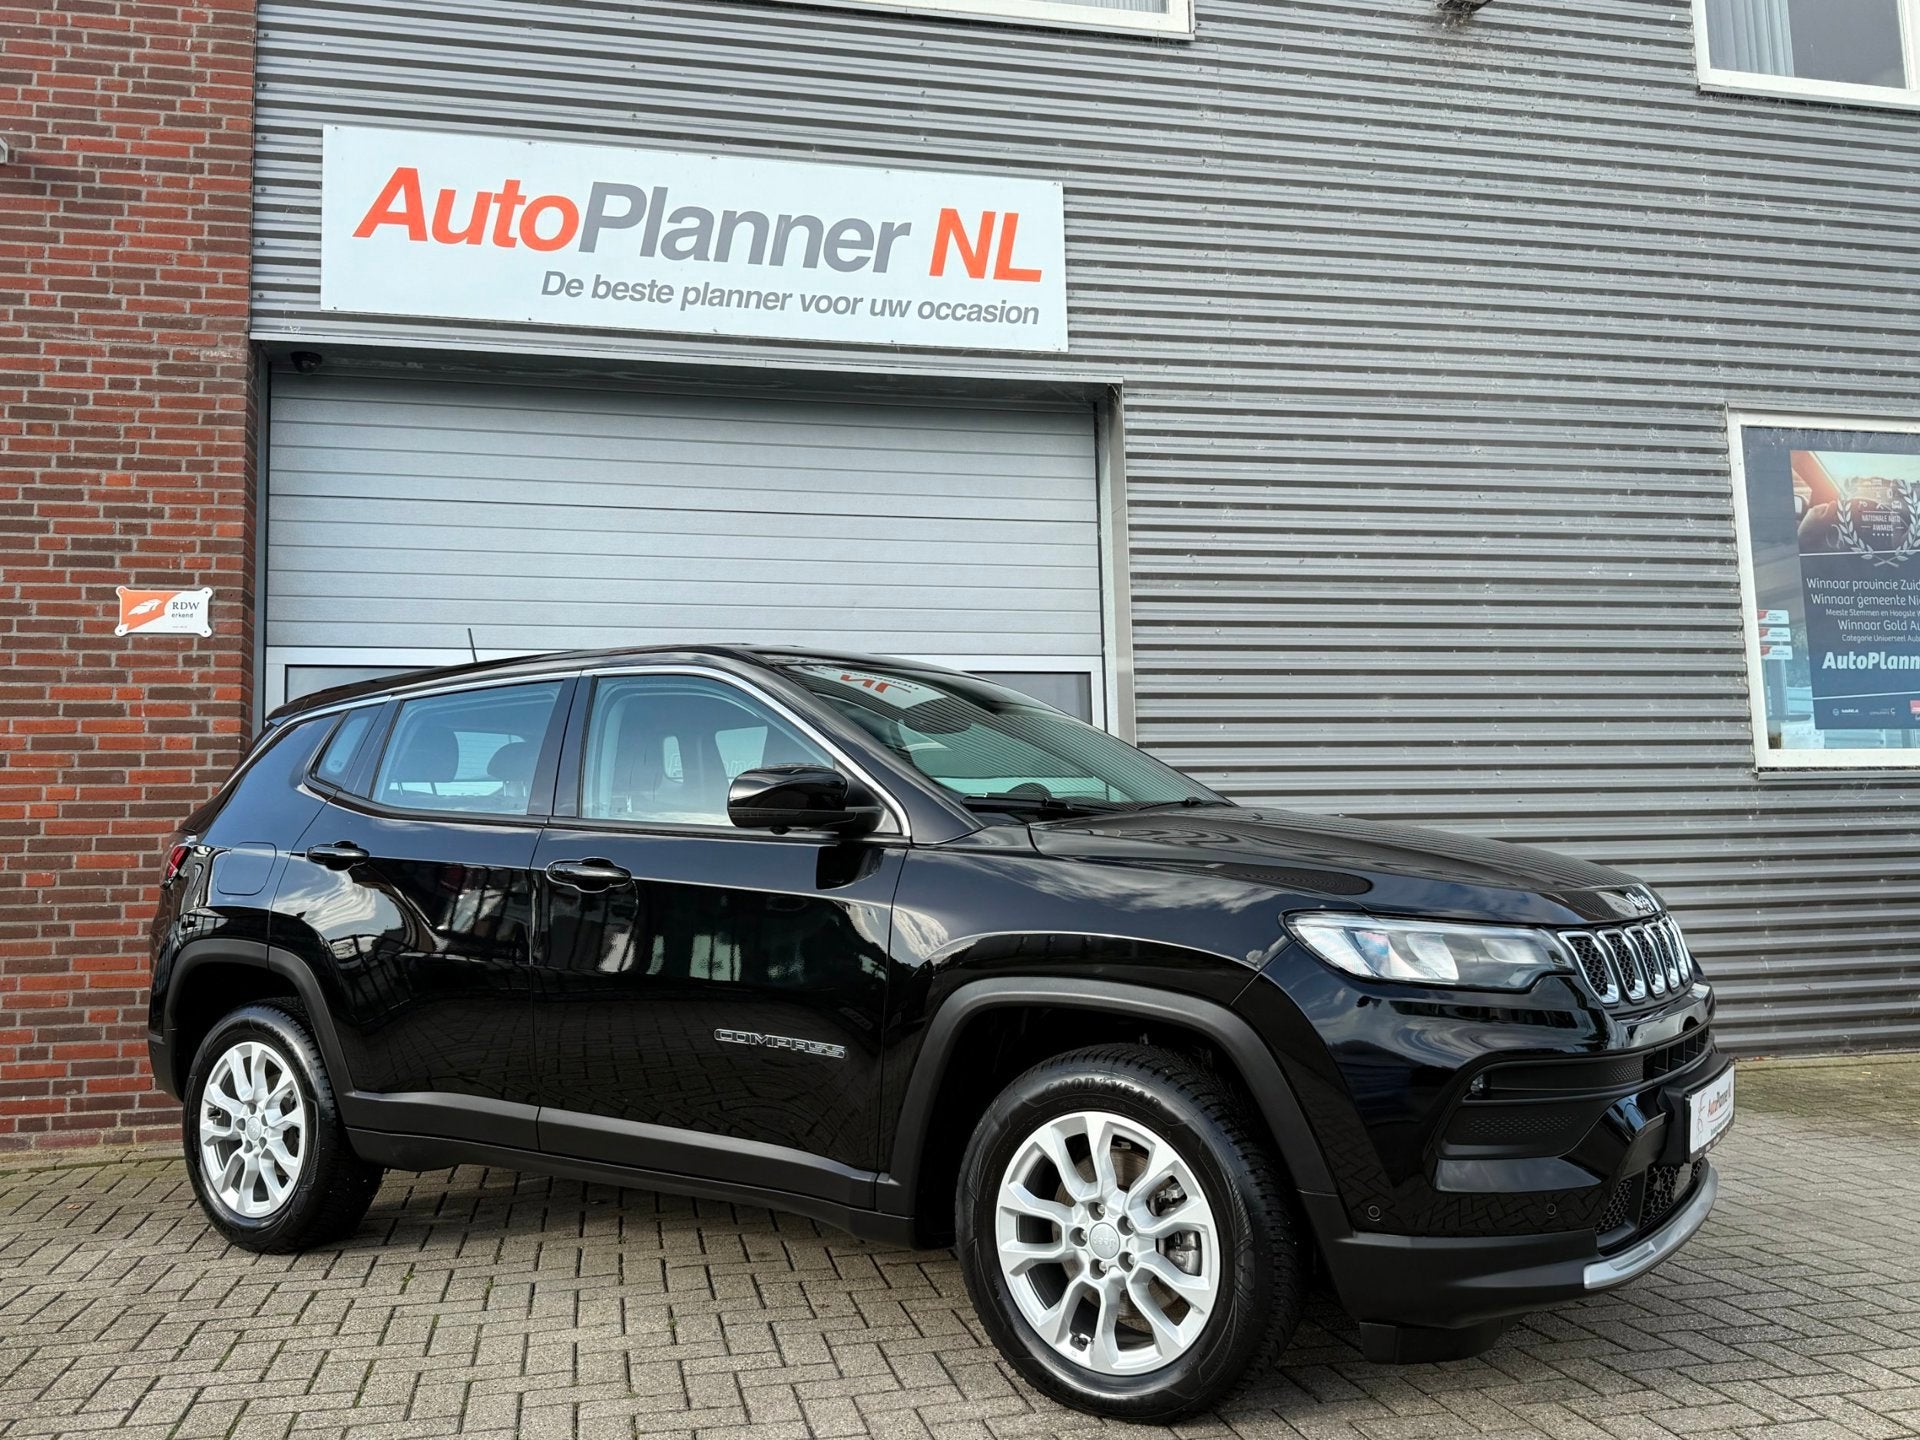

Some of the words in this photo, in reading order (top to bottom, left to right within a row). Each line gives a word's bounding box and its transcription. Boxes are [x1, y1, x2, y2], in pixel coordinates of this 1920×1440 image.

[353, 167, 912, 274] AutoPlanner
[929, 208, 1042, 282] NL
[542, 271, 584, 298] De
[592, 274, 674, 304] beste
[680, 282, 793, 312] planner
[800, 294, 863, 315] voor
[870, 299, 912, 318] uw
[918, 301, 1039, 325] occasion
[1806, 578, 1850, 589] Winnaar
[1852, 579, 1898, 592] provincie
[172, 602, 200, 610] RDW
[1811, 594, 1855, 605] Winnaar
[1857, 594, 1906, 608] gemeente
[1849, 609, 1880, 617] Stemmen
[1889, 610, 1916, 618] Hoogste
[1838, 619, 1881, 631] Winnaar
[1883, 620, 1908, 631] Gold
[1841, 634, 1872, 644] Categorie
[713, 1028, 847, 1059] COMPASS
